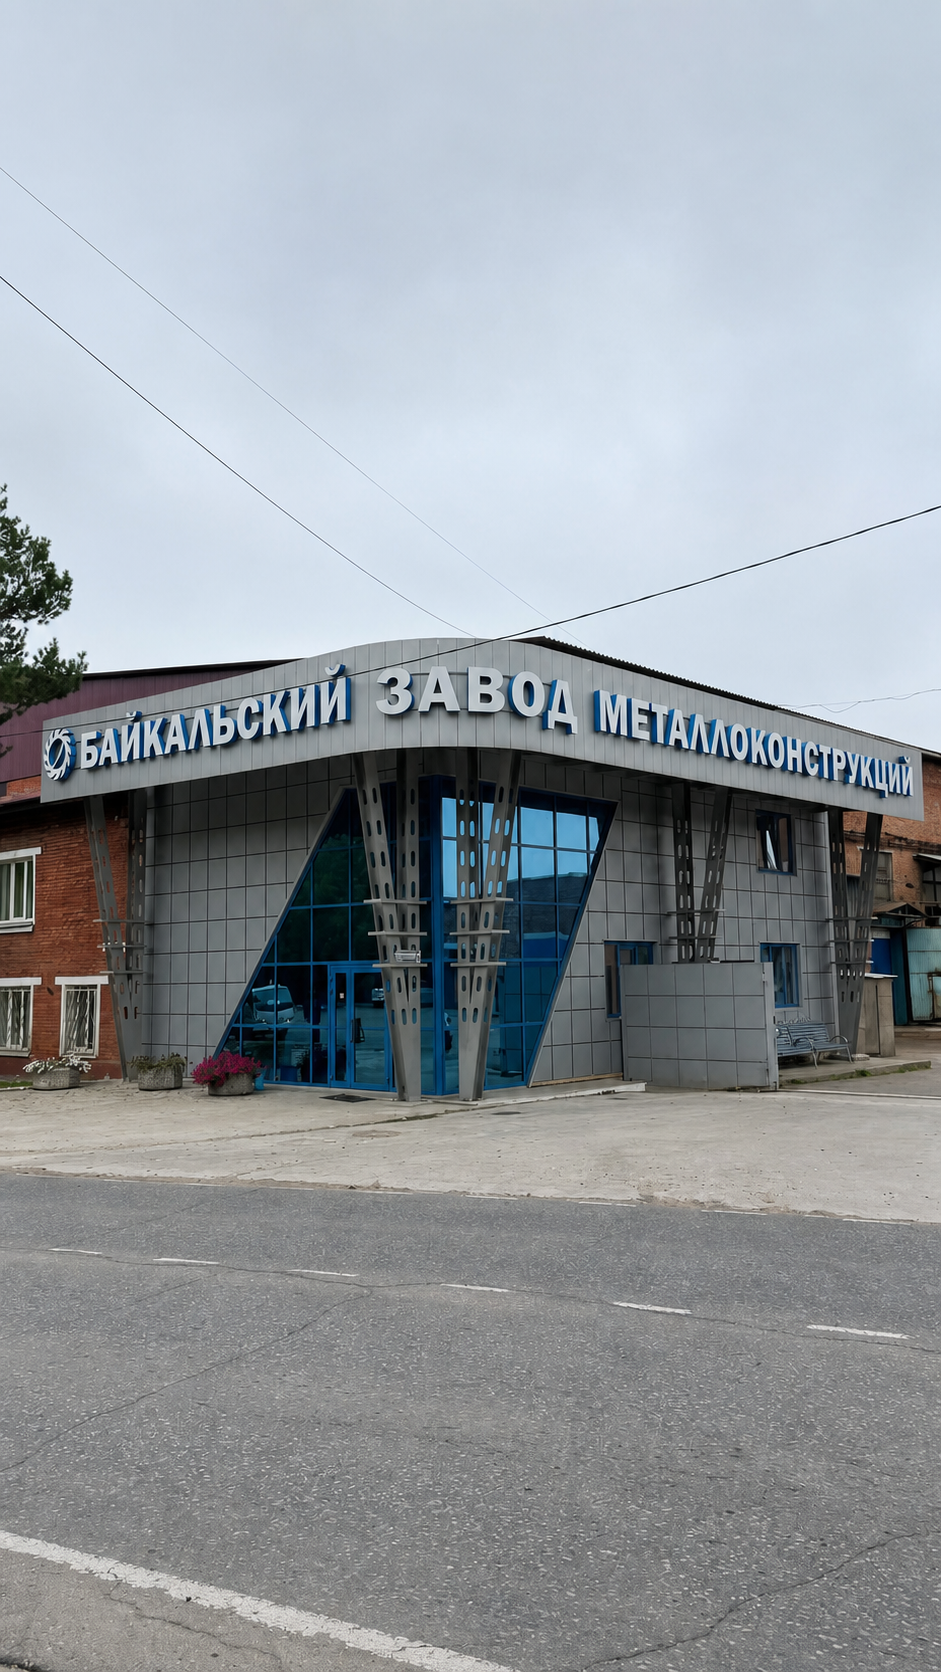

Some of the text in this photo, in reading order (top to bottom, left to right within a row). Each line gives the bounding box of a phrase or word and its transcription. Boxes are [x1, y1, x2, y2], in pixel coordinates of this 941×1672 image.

[80, 664, 914, 798] БАЙКАЛЬСКИЙ ЗАВОД МЕТАЛЛОКОНСТРУКЦИЙ
